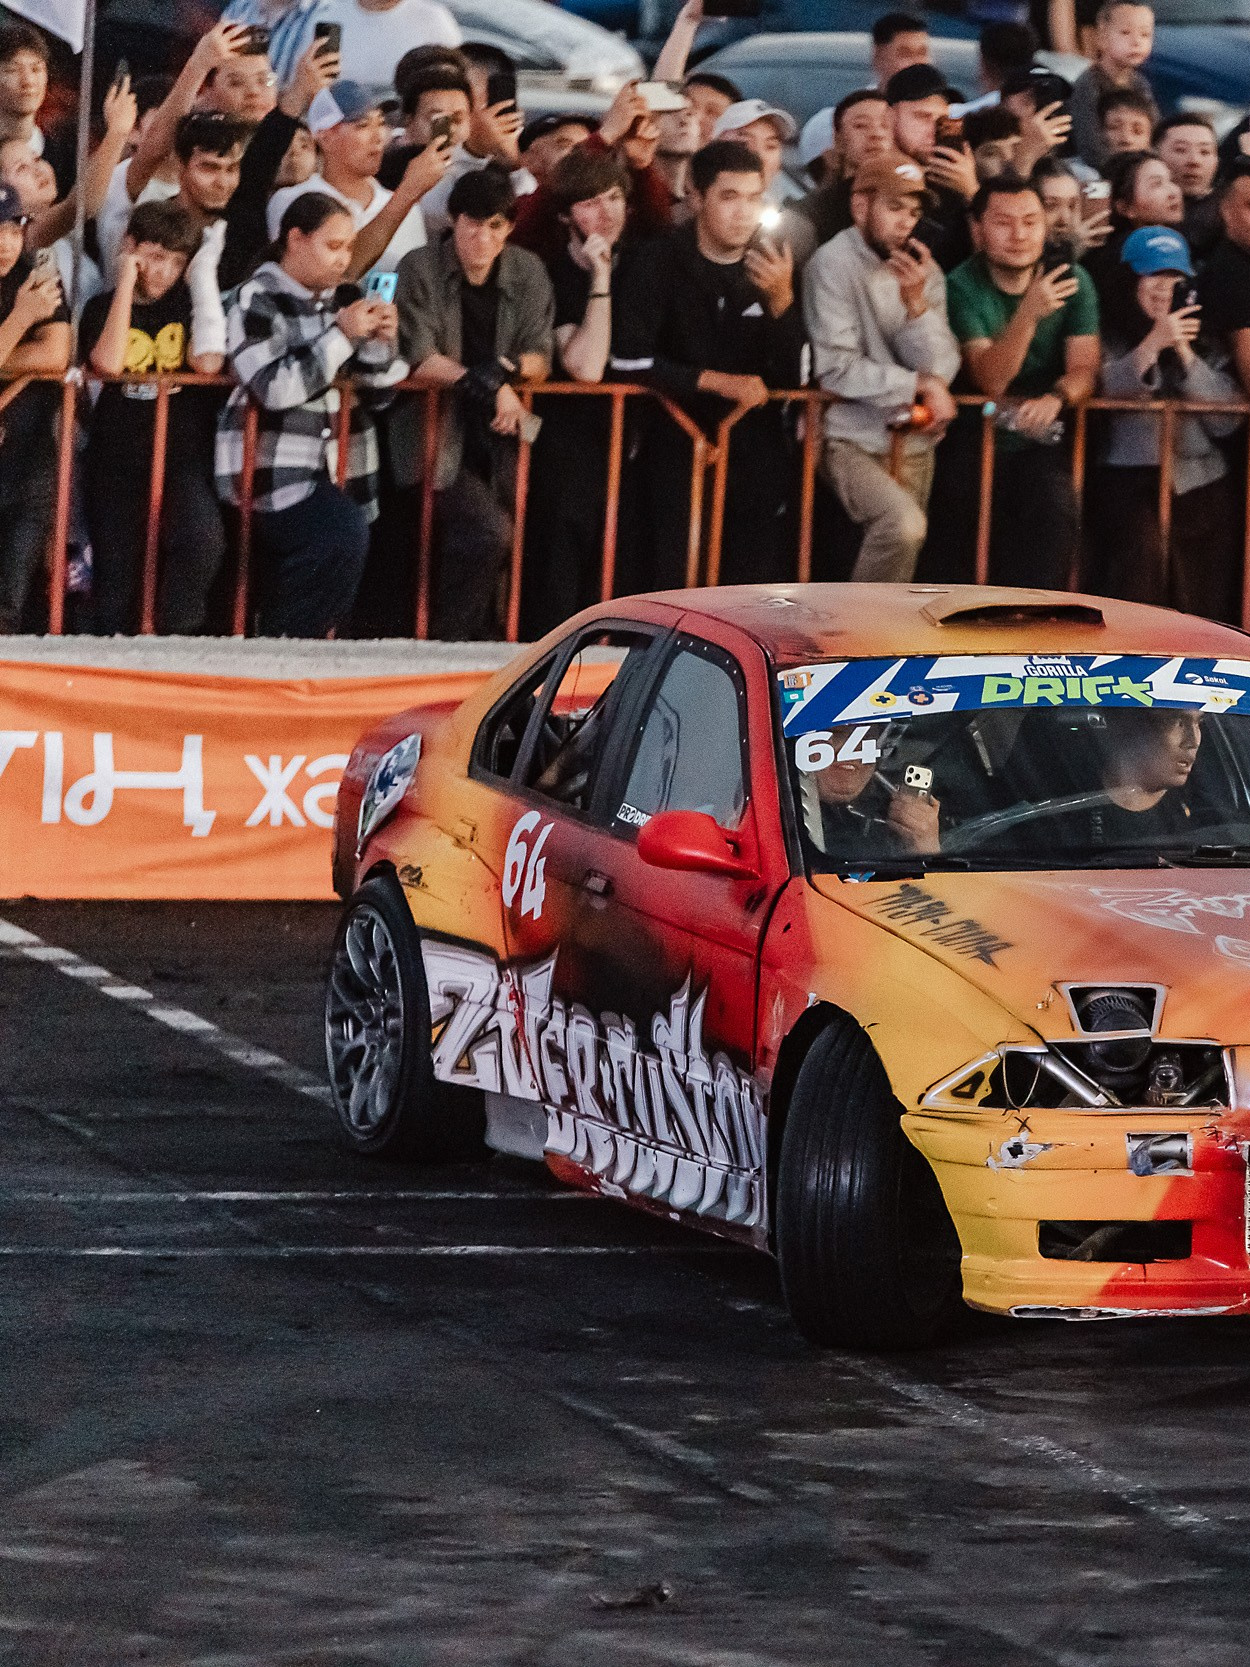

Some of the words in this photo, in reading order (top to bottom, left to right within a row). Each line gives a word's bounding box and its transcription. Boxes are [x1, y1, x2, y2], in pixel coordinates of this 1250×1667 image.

[1025, 664, 1089, 677] GORILLA
[981, 676, 1153, 707] DRIFT
[795, 725, 882, 772] 64
[502, 810, 555, 920] 64
